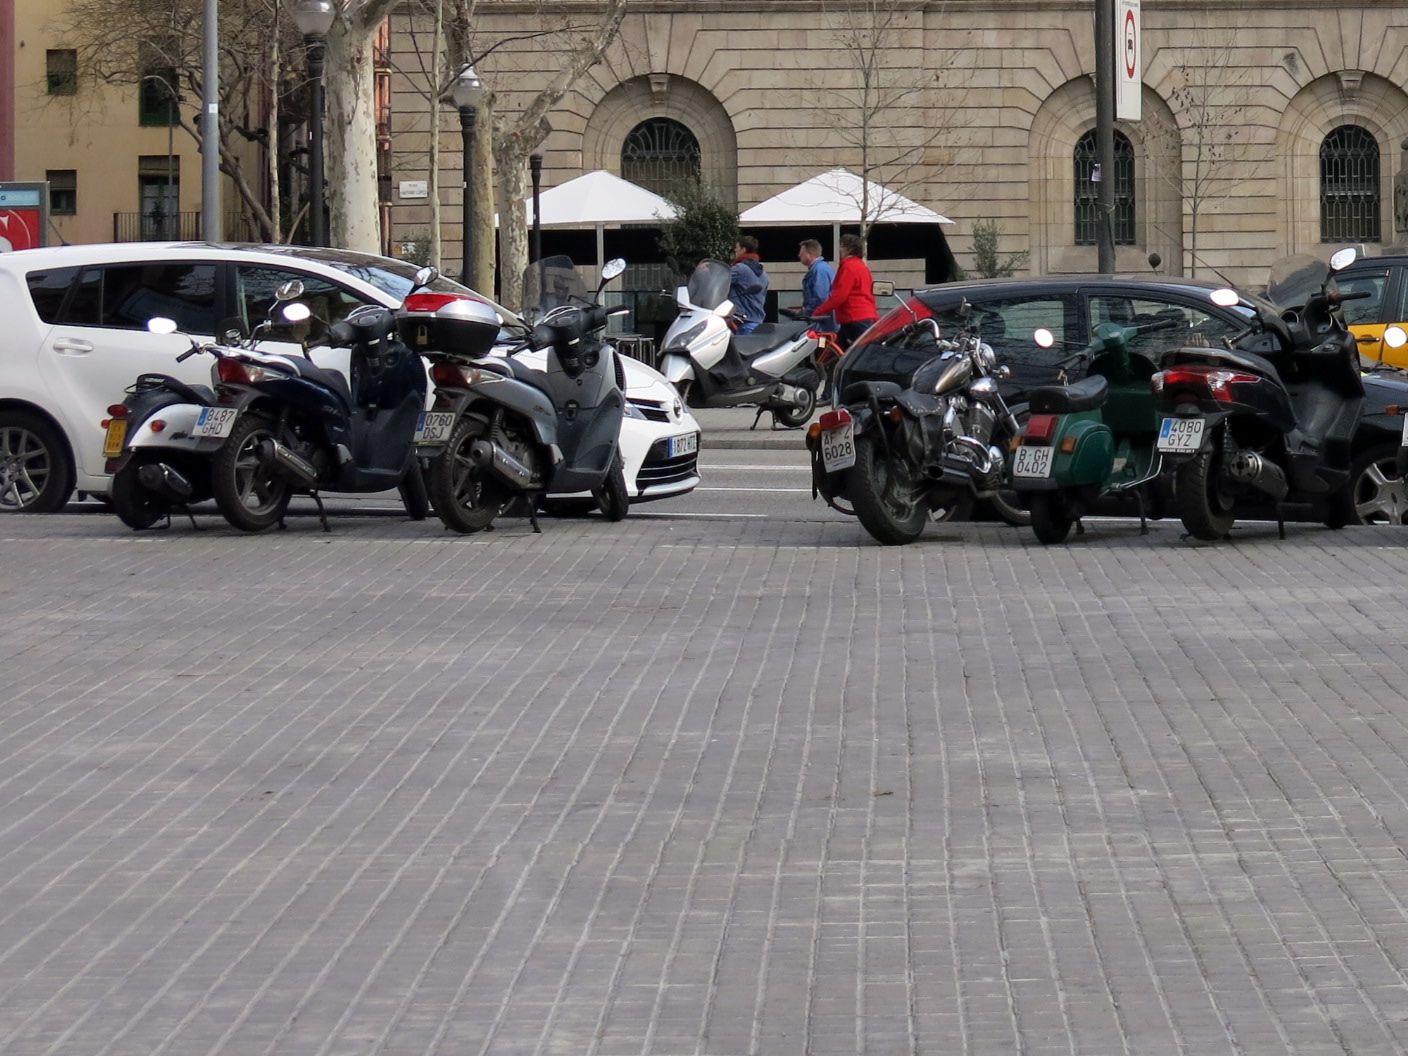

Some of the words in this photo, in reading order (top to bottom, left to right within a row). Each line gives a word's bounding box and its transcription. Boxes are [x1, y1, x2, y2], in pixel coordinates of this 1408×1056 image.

[206, 408, 235, 423] 8487
[426, 414, 453, 427] 0760
[201, 422, 223, 435] GHD
[423, 426, 445, 439] DSJ
[1171, 420, 1202, 434] 4080
[1167, 434, 1192, 447] GYZ
[824, 441, 852, 461] 6028
[1016, 461, 1047, 475] 0402
